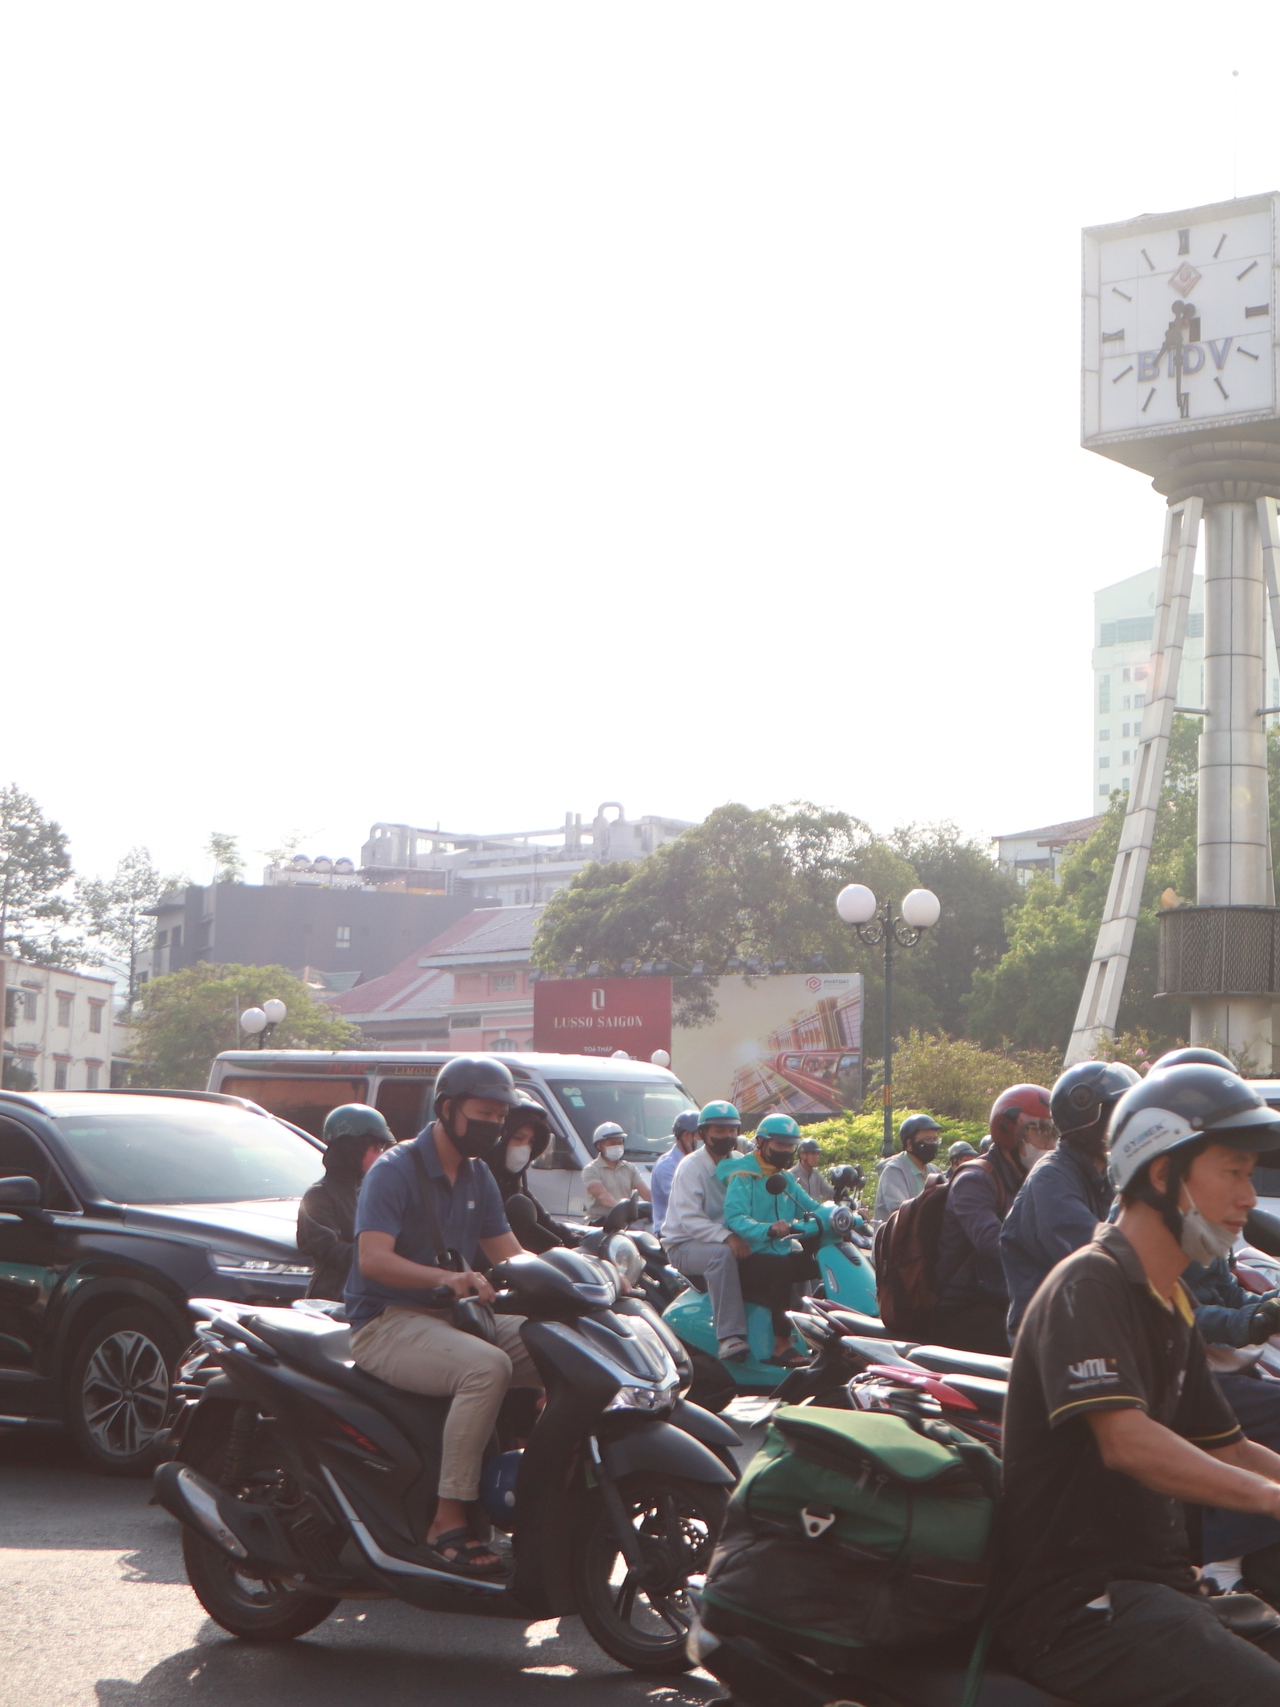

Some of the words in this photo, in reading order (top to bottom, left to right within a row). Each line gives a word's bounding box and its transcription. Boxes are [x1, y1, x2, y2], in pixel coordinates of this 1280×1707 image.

[1138, 336, 1233, 383] BIDV
[554, 1016, 594, 1028] LUSSO
[597, 1015, 643, 1027] SAIGON
[394, 1066, 440, 1076] LIMOUS
